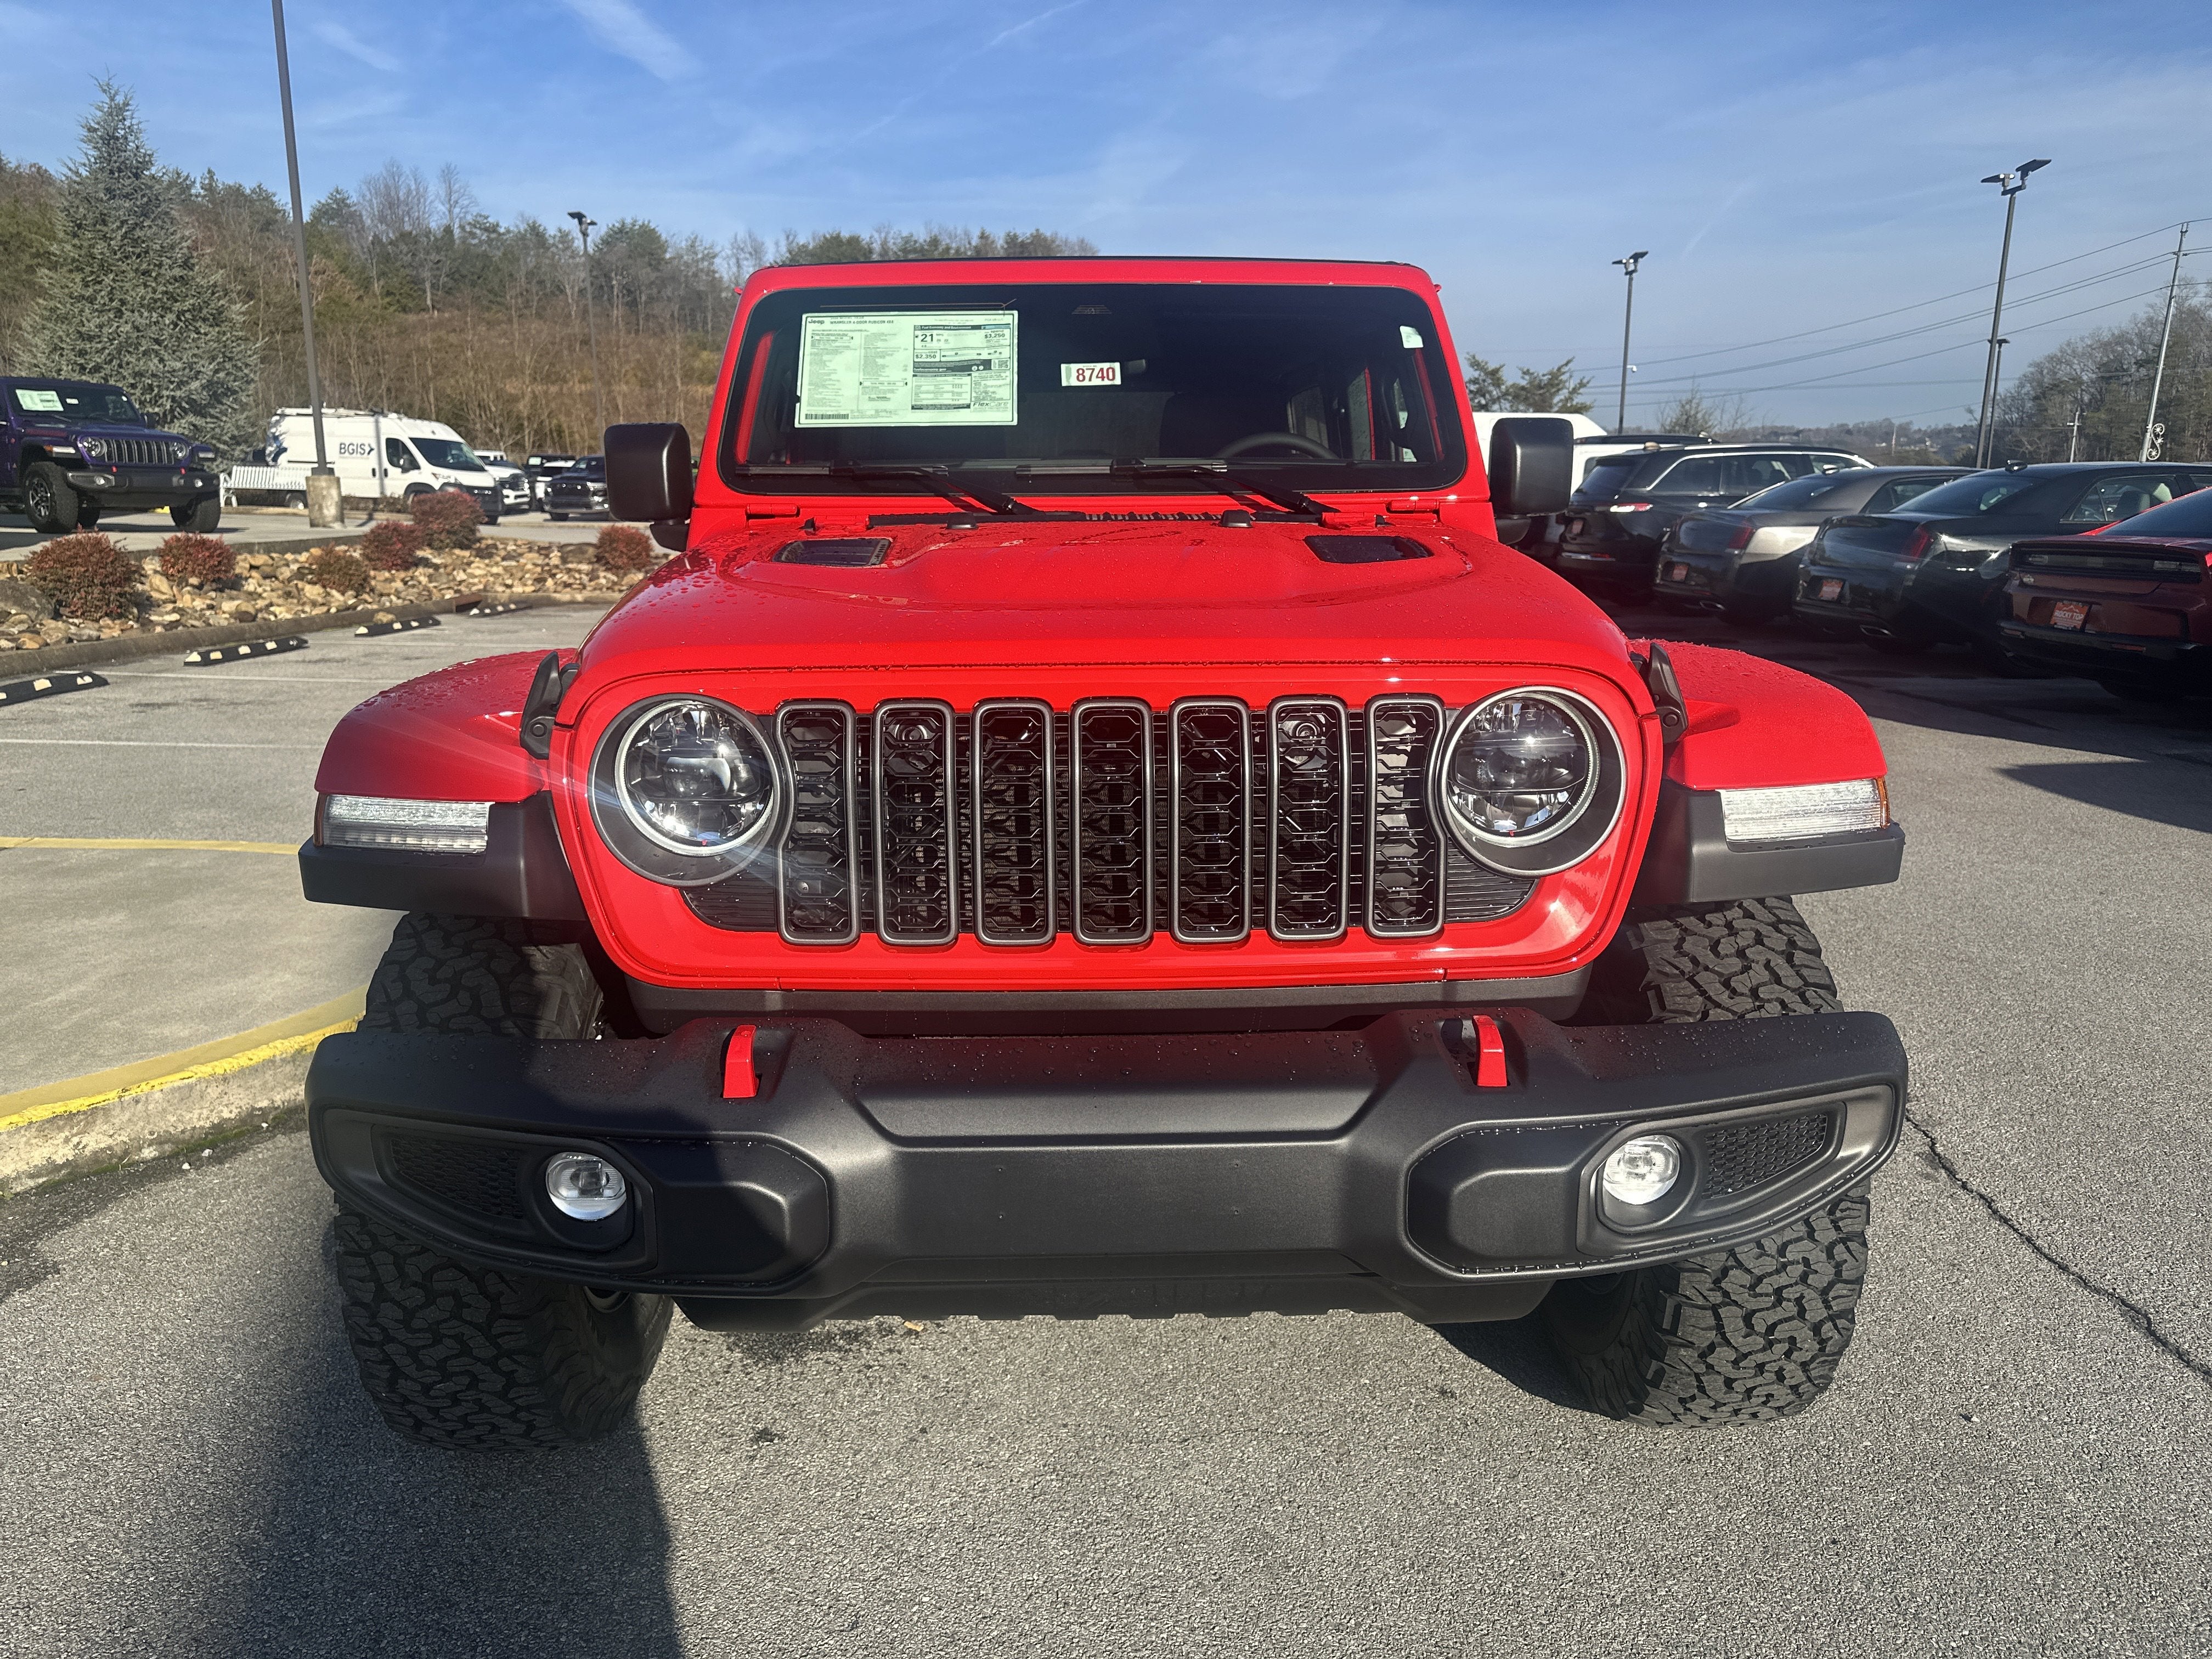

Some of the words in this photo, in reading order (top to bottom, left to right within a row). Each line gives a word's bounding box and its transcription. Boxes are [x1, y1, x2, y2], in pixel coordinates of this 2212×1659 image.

[921, 334, 934, 342] 21
[1076, 366, 1115, 382] 8740
[339, 443, 366, 455] BGIS
[2054, 610, 2073, 619] ROCKY
[2073, 612, 2085, 620] TOP
